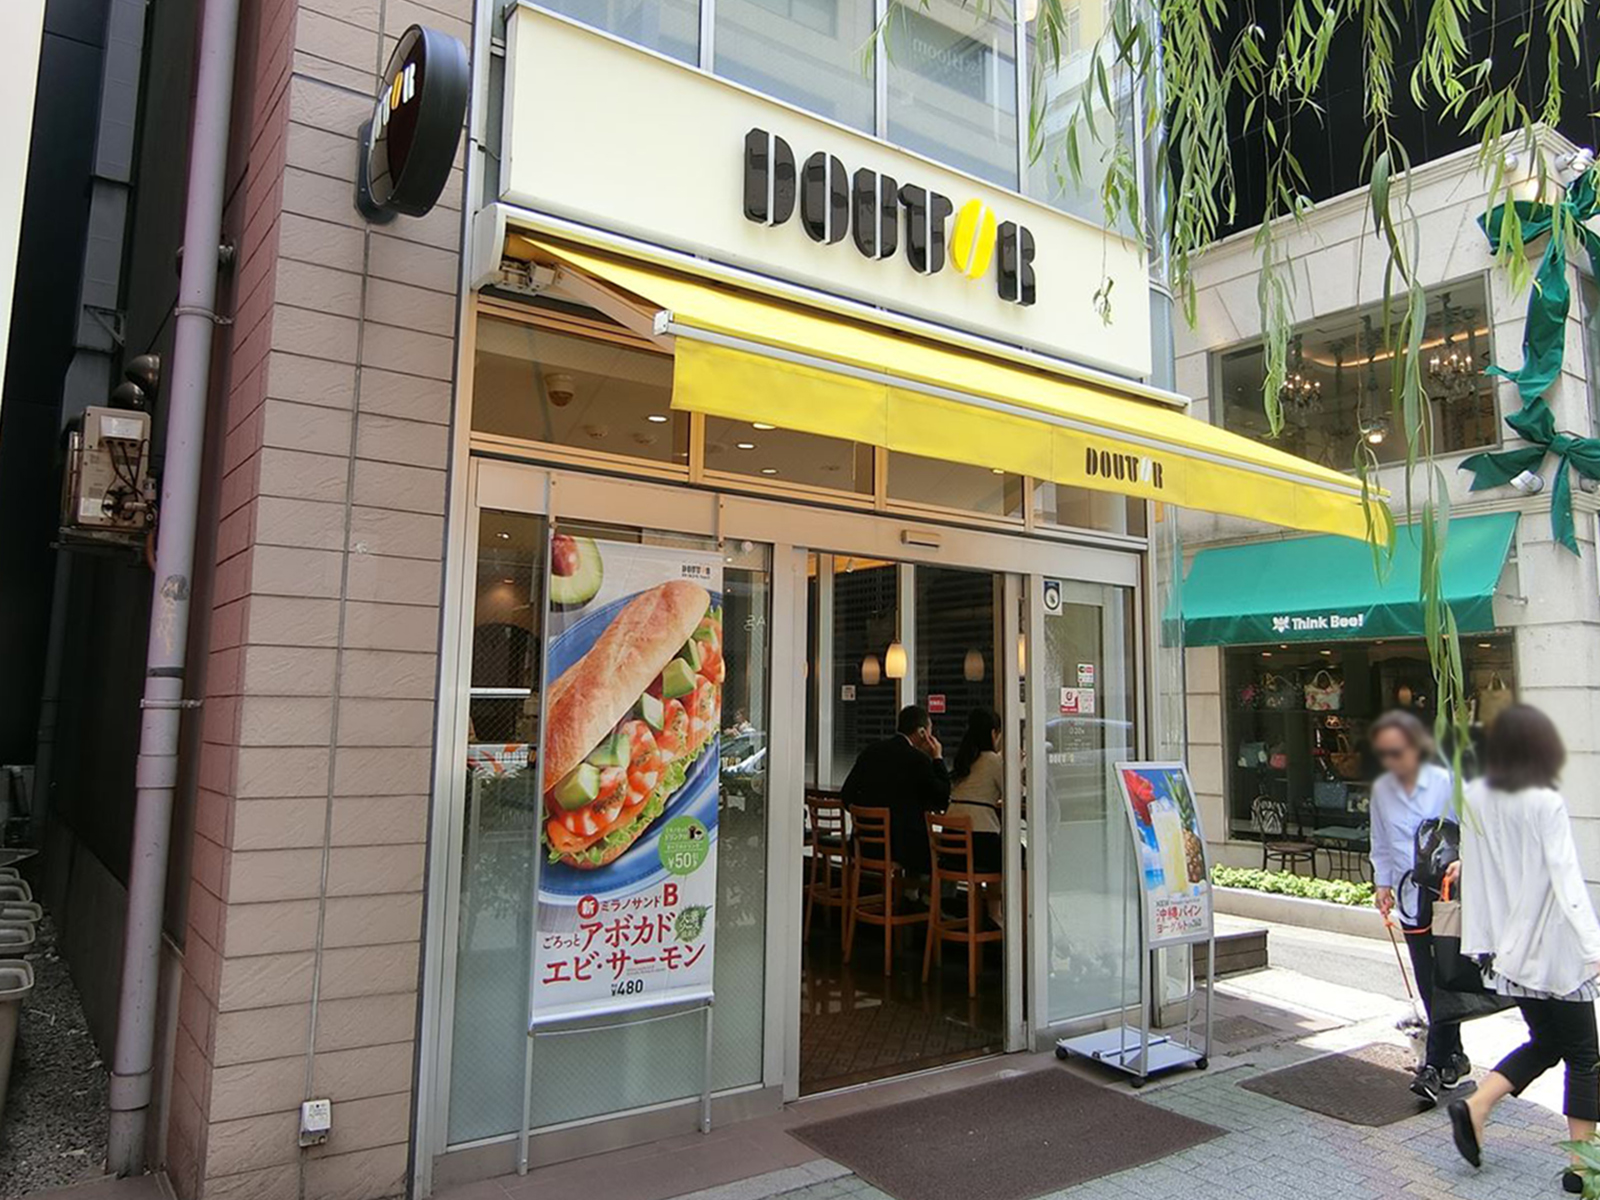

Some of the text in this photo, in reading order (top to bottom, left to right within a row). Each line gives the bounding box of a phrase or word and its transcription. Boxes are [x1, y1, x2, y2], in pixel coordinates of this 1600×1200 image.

[743, 127, 1036, 306] DOUTOR
[1085, 447, 1163, 489] DOUTOR
[1292, 615, 1329, 630] Think
[543, 912, 676, 952] ごろっと アボカド
[542, 944, 706, 985] エビ・サーモン
